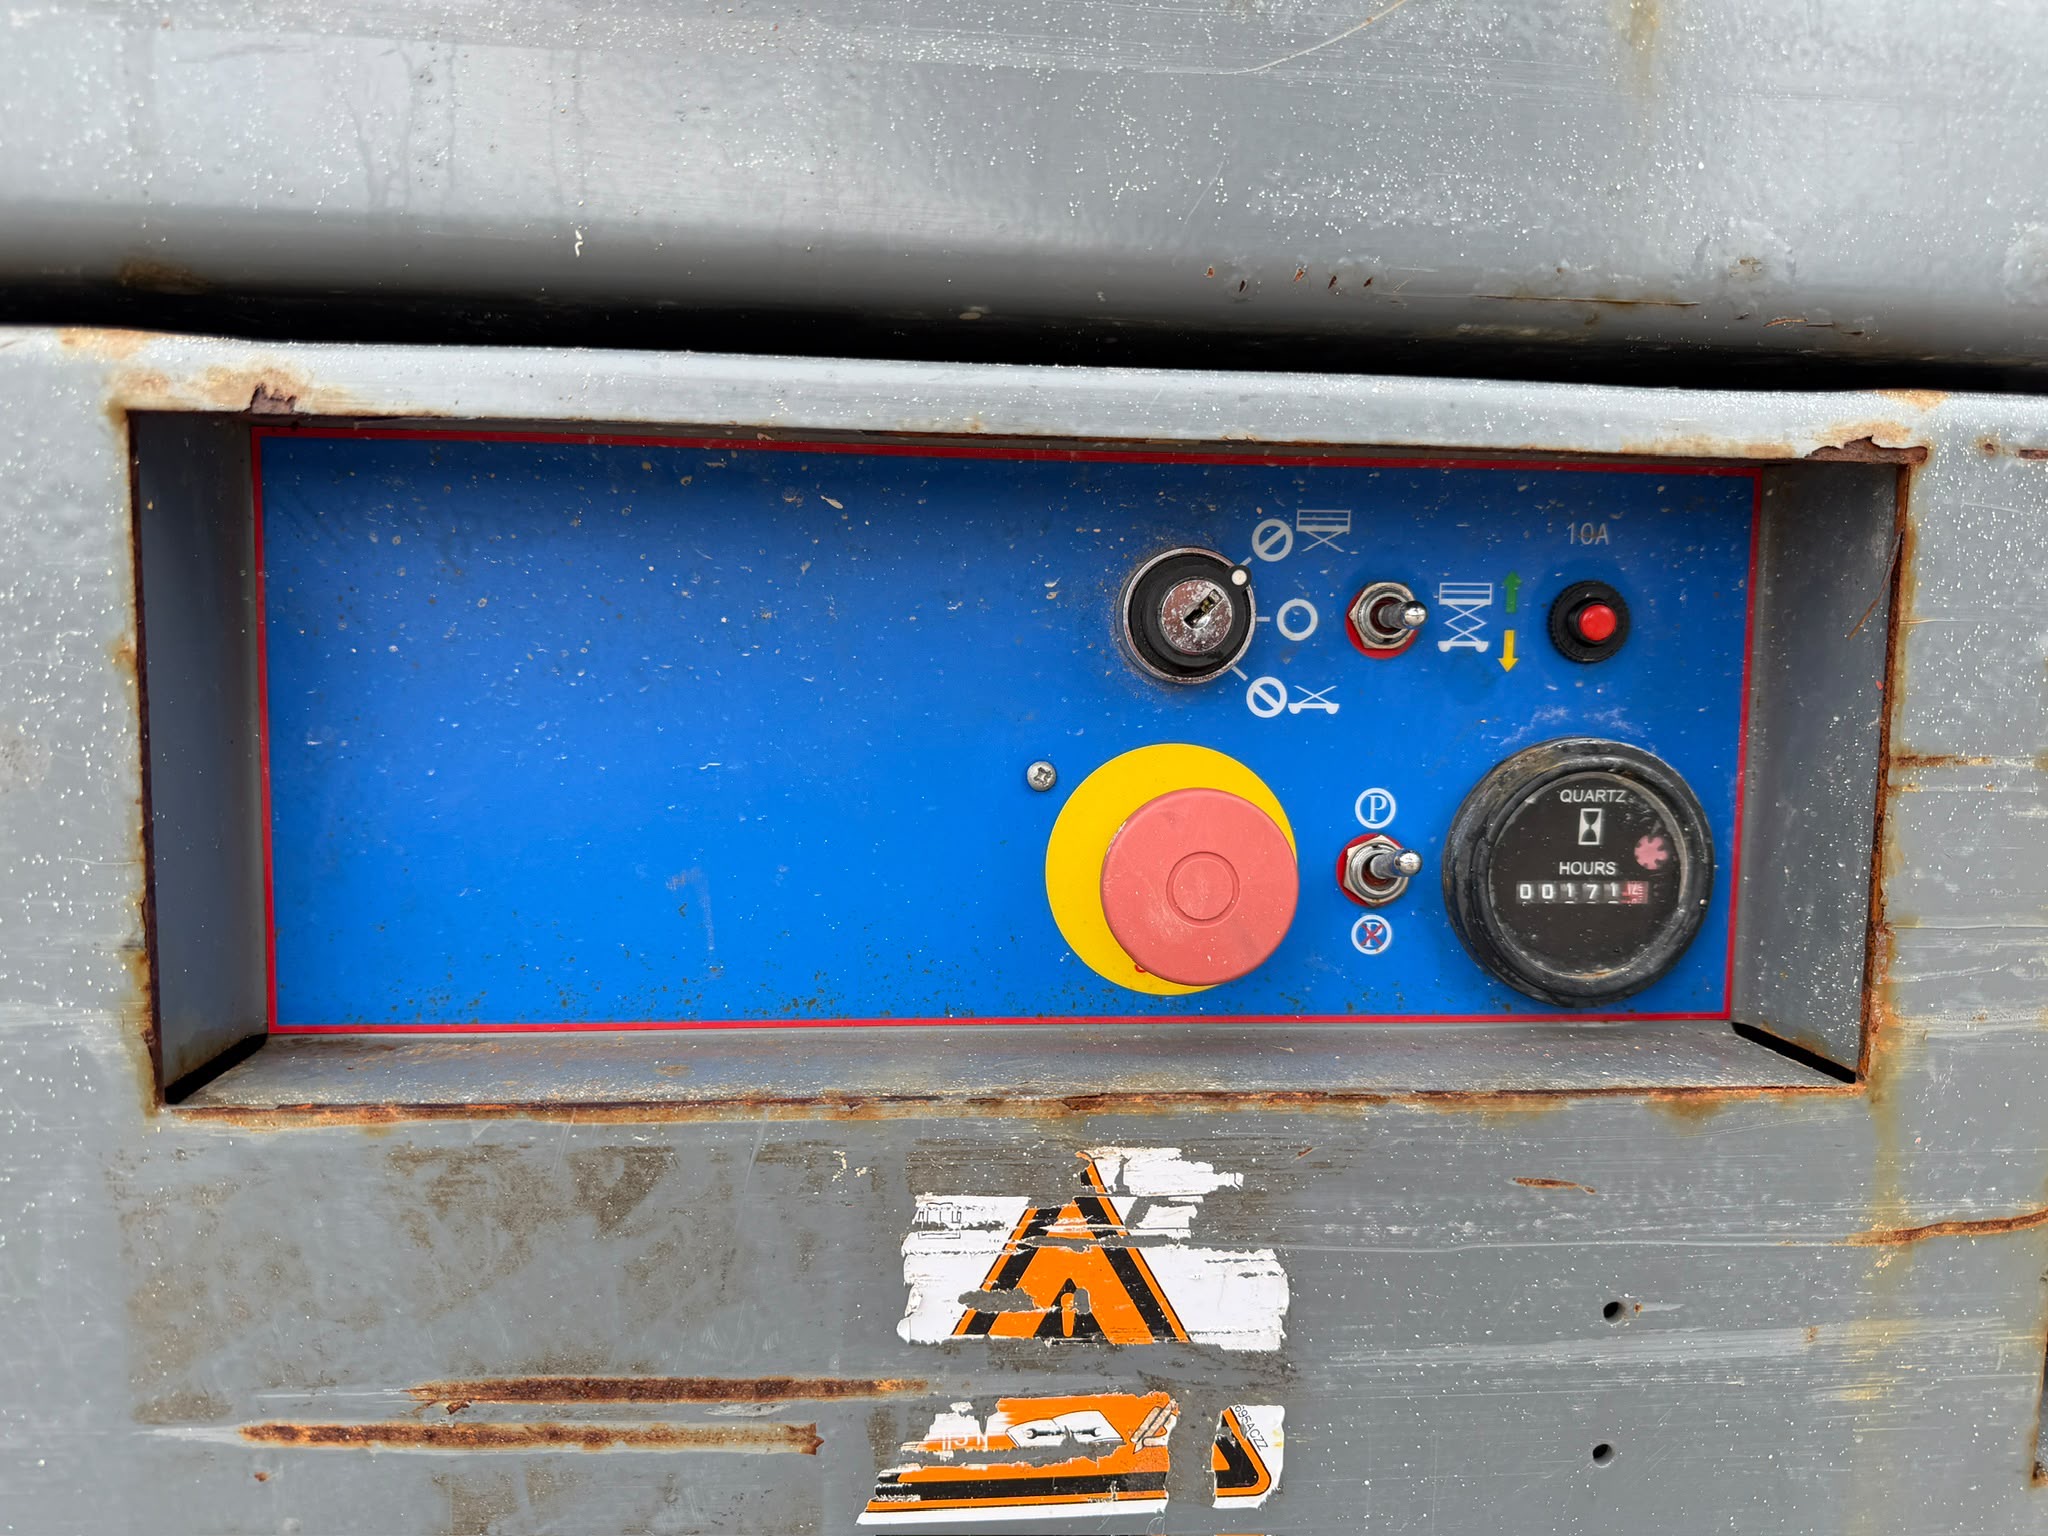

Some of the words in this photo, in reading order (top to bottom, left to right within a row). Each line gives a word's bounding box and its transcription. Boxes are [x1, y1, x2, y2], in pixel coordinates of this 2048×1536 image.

[1567, 522, 1609, 545] 10A
[1560, 789, 1627, 803] QUARTZ
[1367, 795, 1387, 822] P
[1559, 861, 1617, 875] HOURS
